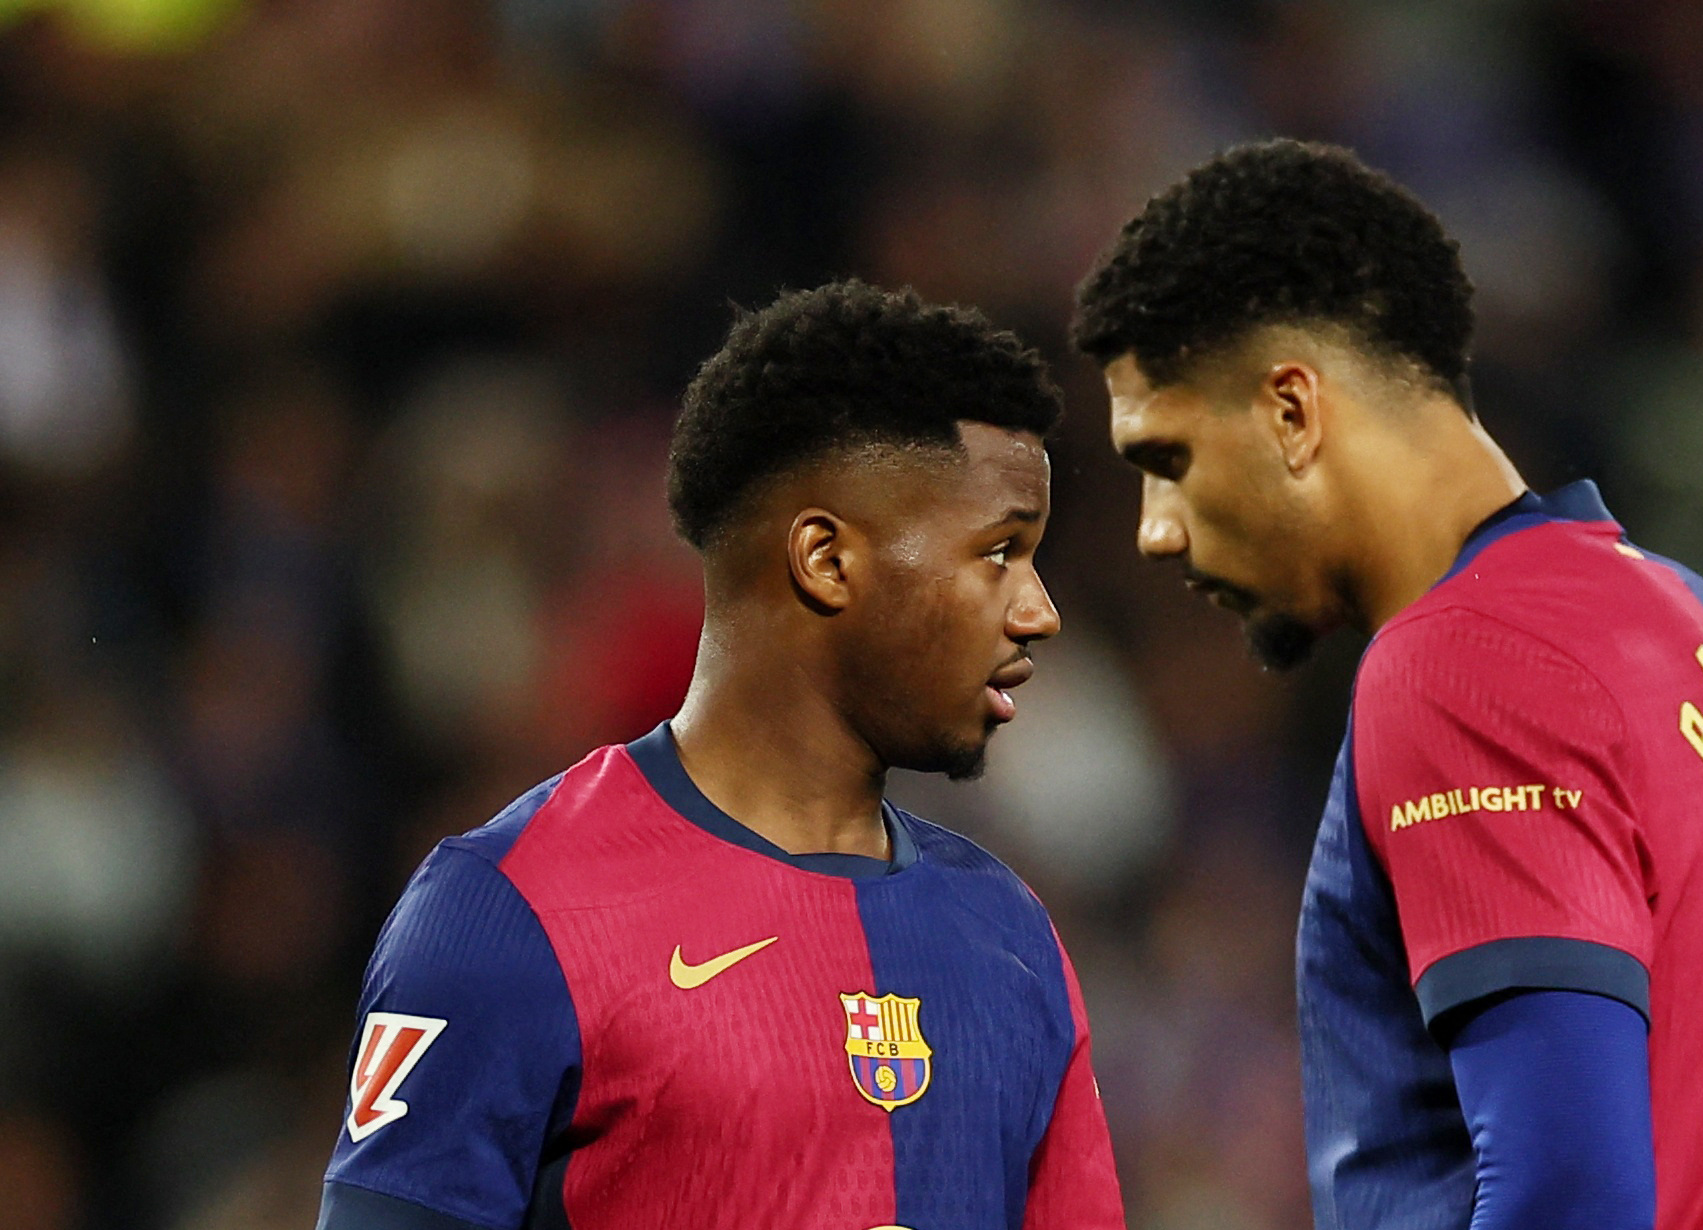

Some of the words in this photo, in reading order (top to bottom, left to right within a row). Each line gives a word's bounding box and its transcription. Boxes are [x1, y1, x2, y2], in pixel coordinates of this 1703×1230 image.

[1390, 784, 1546, 832] AMBILIGHT
[1552, 786, 1583, 810] tv
[865, 1041, 900, 1057] FCB
